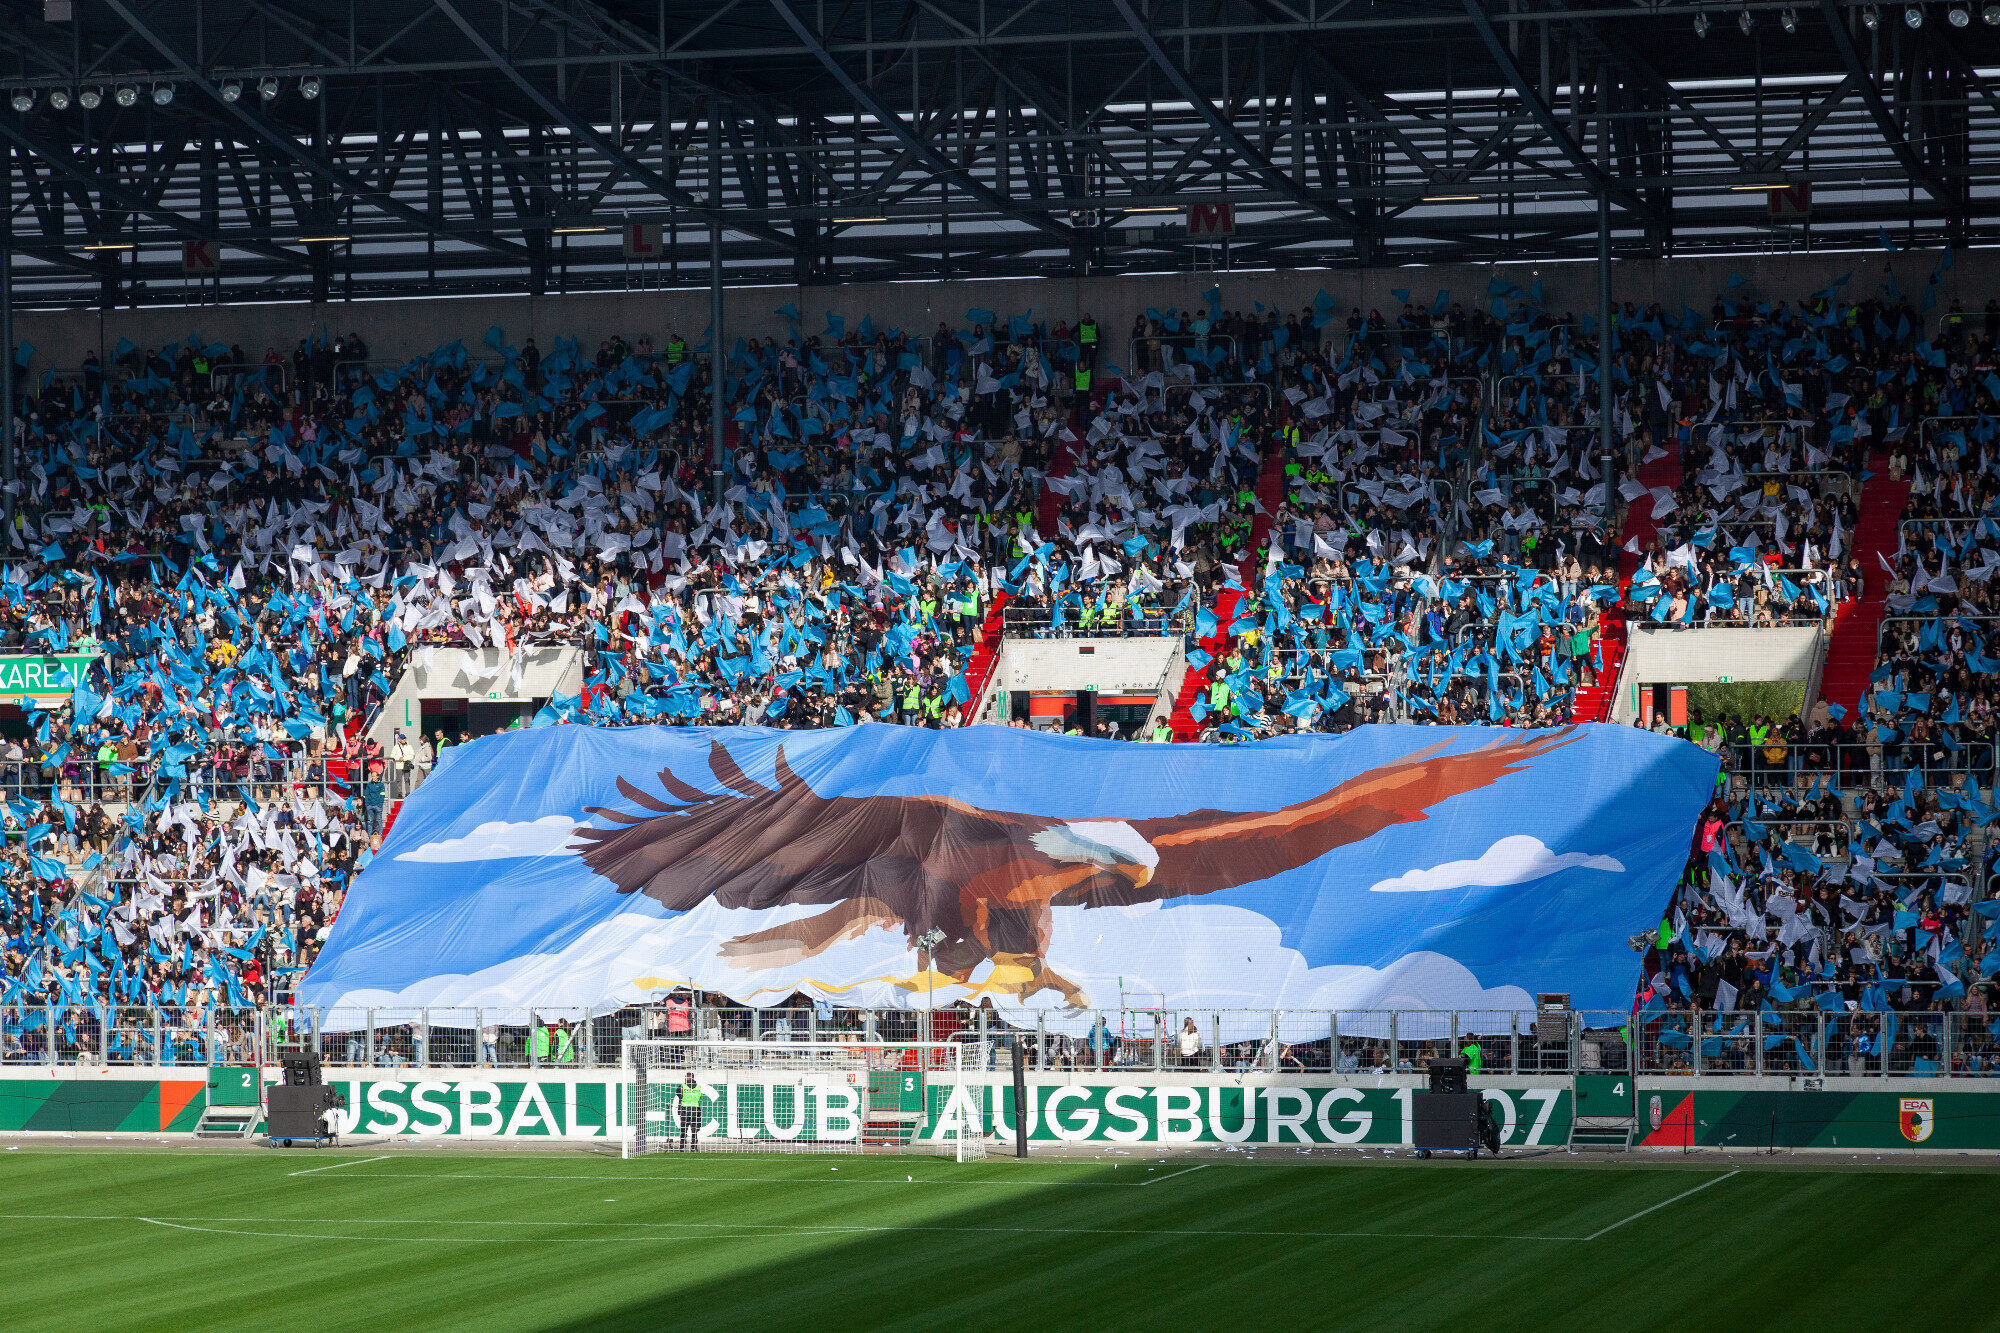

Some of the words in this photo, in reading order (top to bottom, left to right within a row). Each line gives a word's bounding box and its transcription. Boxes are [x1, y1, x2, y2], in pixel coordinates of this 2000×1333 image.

[1770, 183, 1807, 212] N
[1190, 204, 1232, 233] M
[632, 225, 652, 252] L
[186, 240, 215, 268] K
[405, 699, 412, 726] L
[241, 1073, 252, 1087] 2
[904, 1077, 914, 1092] 3
[1612, 1082, 1625, 1097] 4
[275, 1080, 861, 1141] USSBALL-CLUB
[931, 1084, 1373, 1145] AUGSBURG
[1391, 1088, 1562, 1146] 107
